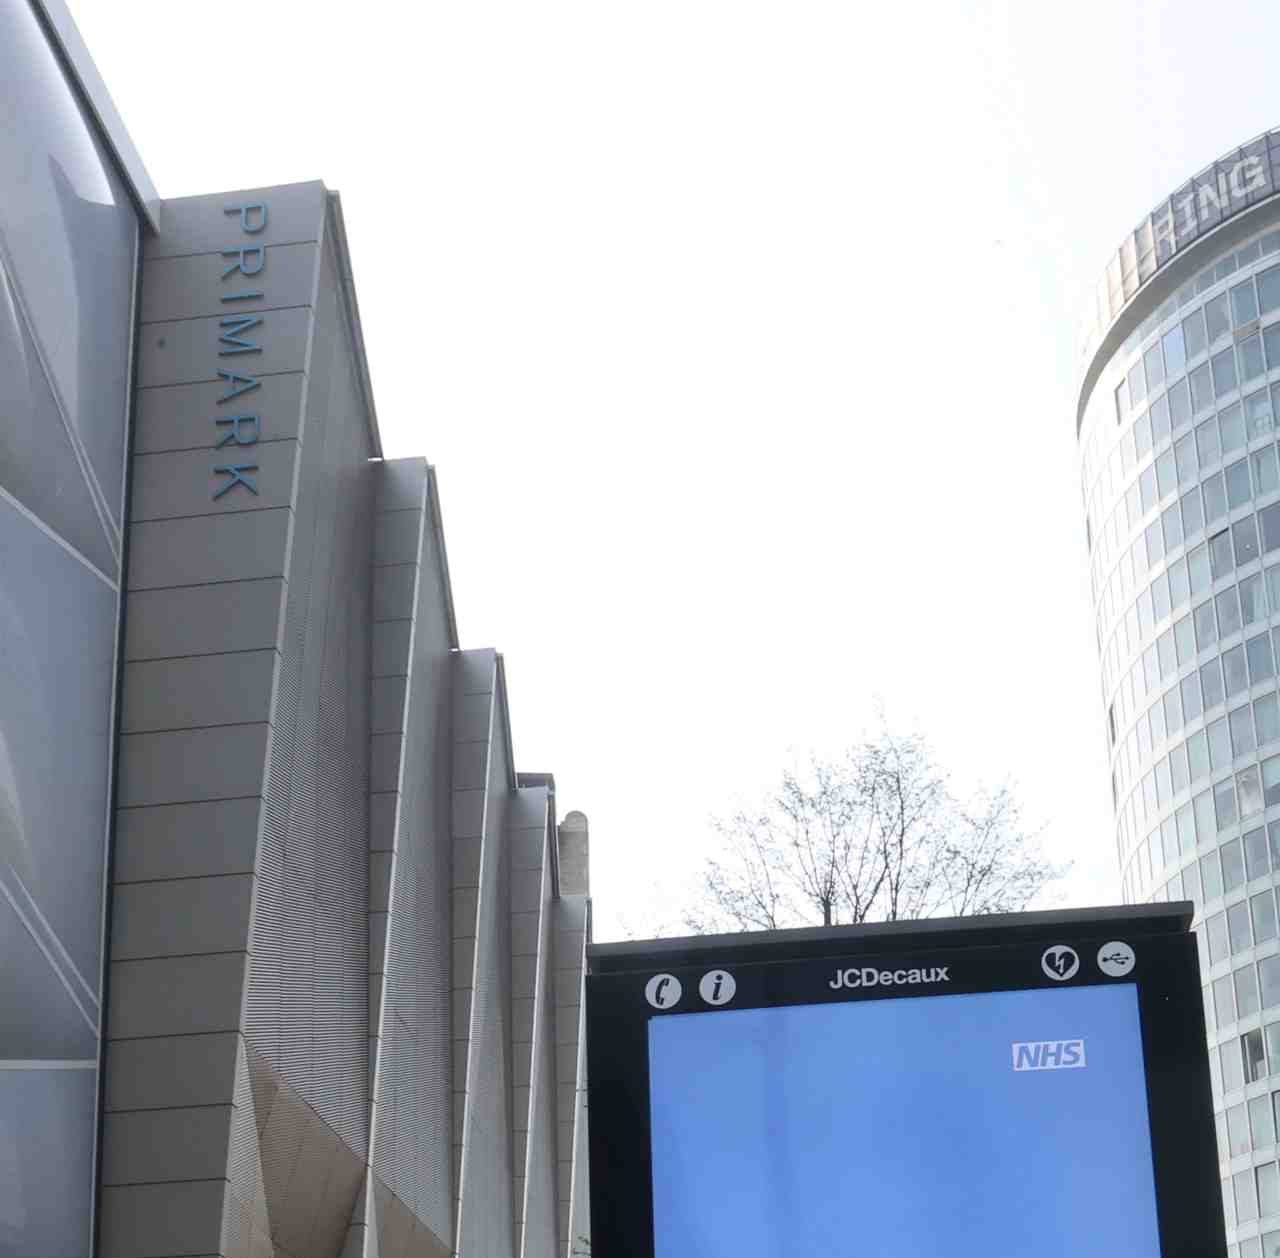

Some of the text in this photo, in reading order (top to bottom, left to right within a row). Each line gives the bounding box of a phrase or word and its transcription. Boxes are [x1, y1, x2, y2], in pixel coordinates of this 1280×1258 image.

[211, 203, 267, 502] PRIMARK
[829, 967, 950, 989] JCDecaux
[1015, 1041, 1083, 1069] NHS
